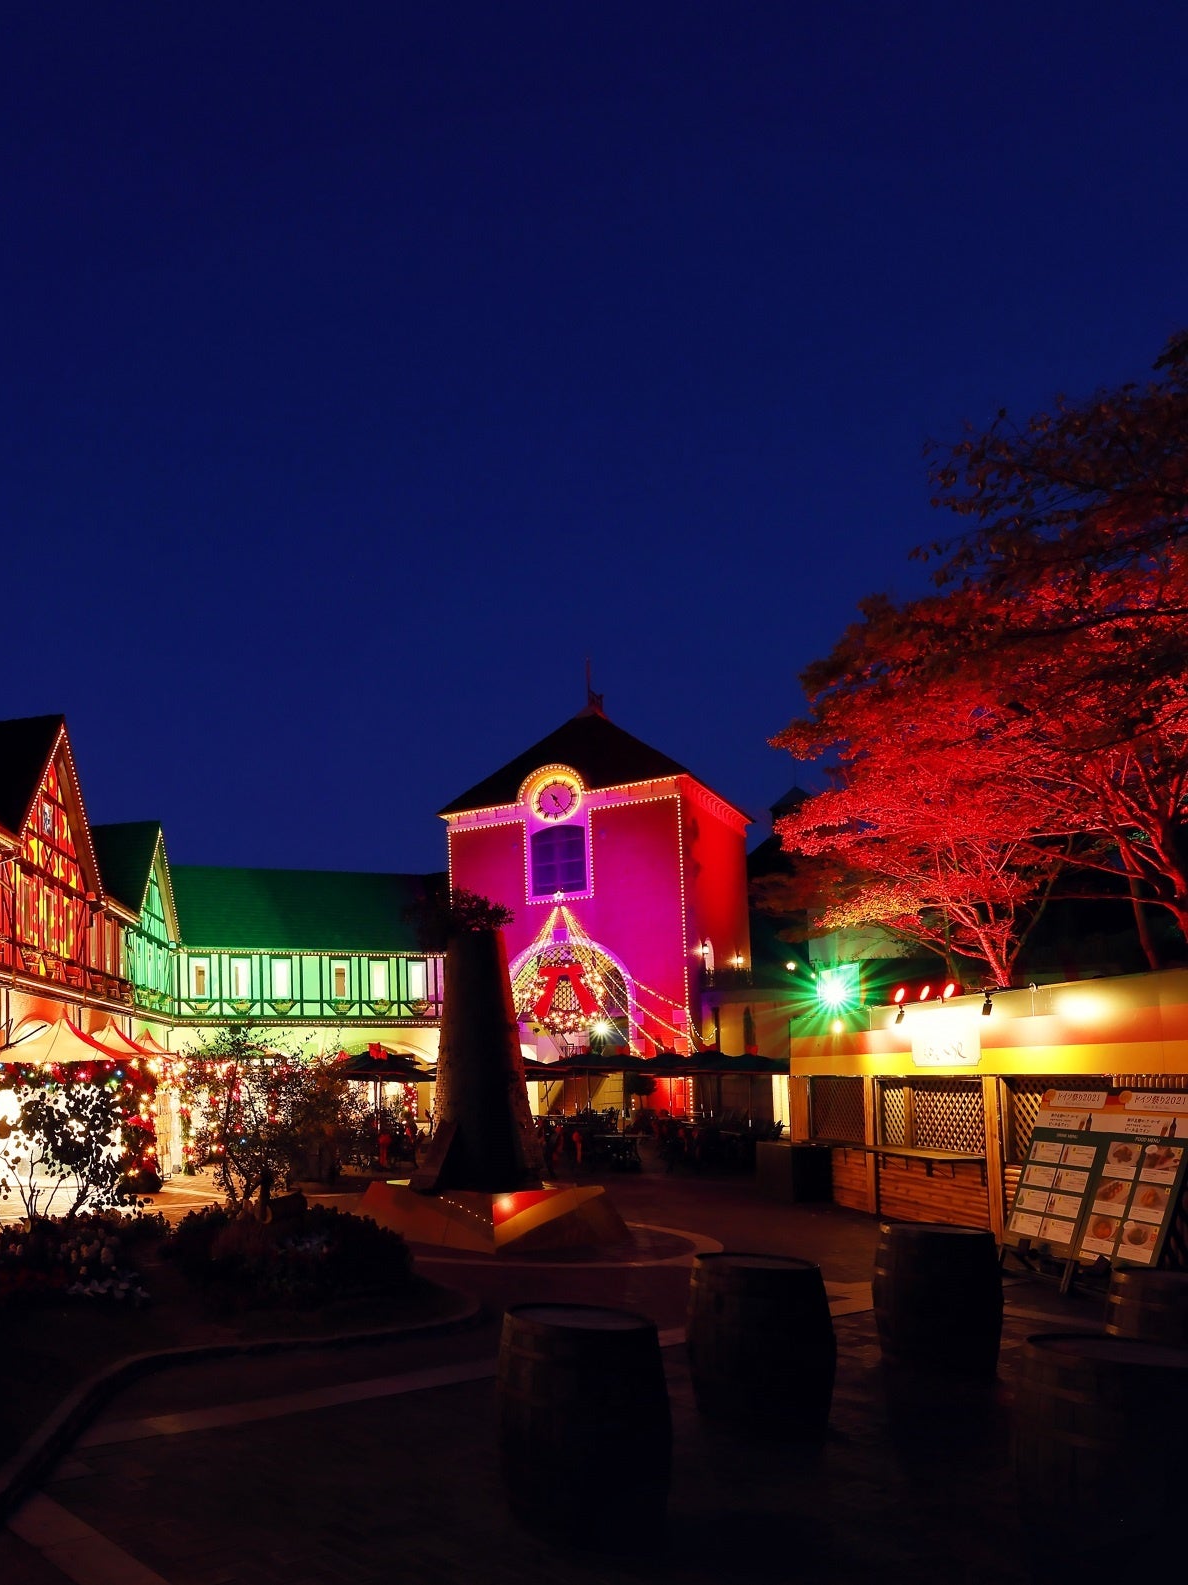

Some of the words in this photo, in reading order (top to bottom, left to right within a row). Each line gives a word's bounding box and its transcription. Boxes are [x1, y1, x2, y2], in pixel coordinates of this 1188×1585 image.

[1134, 1095, 1186, 1105] ドイツ祭り2021
